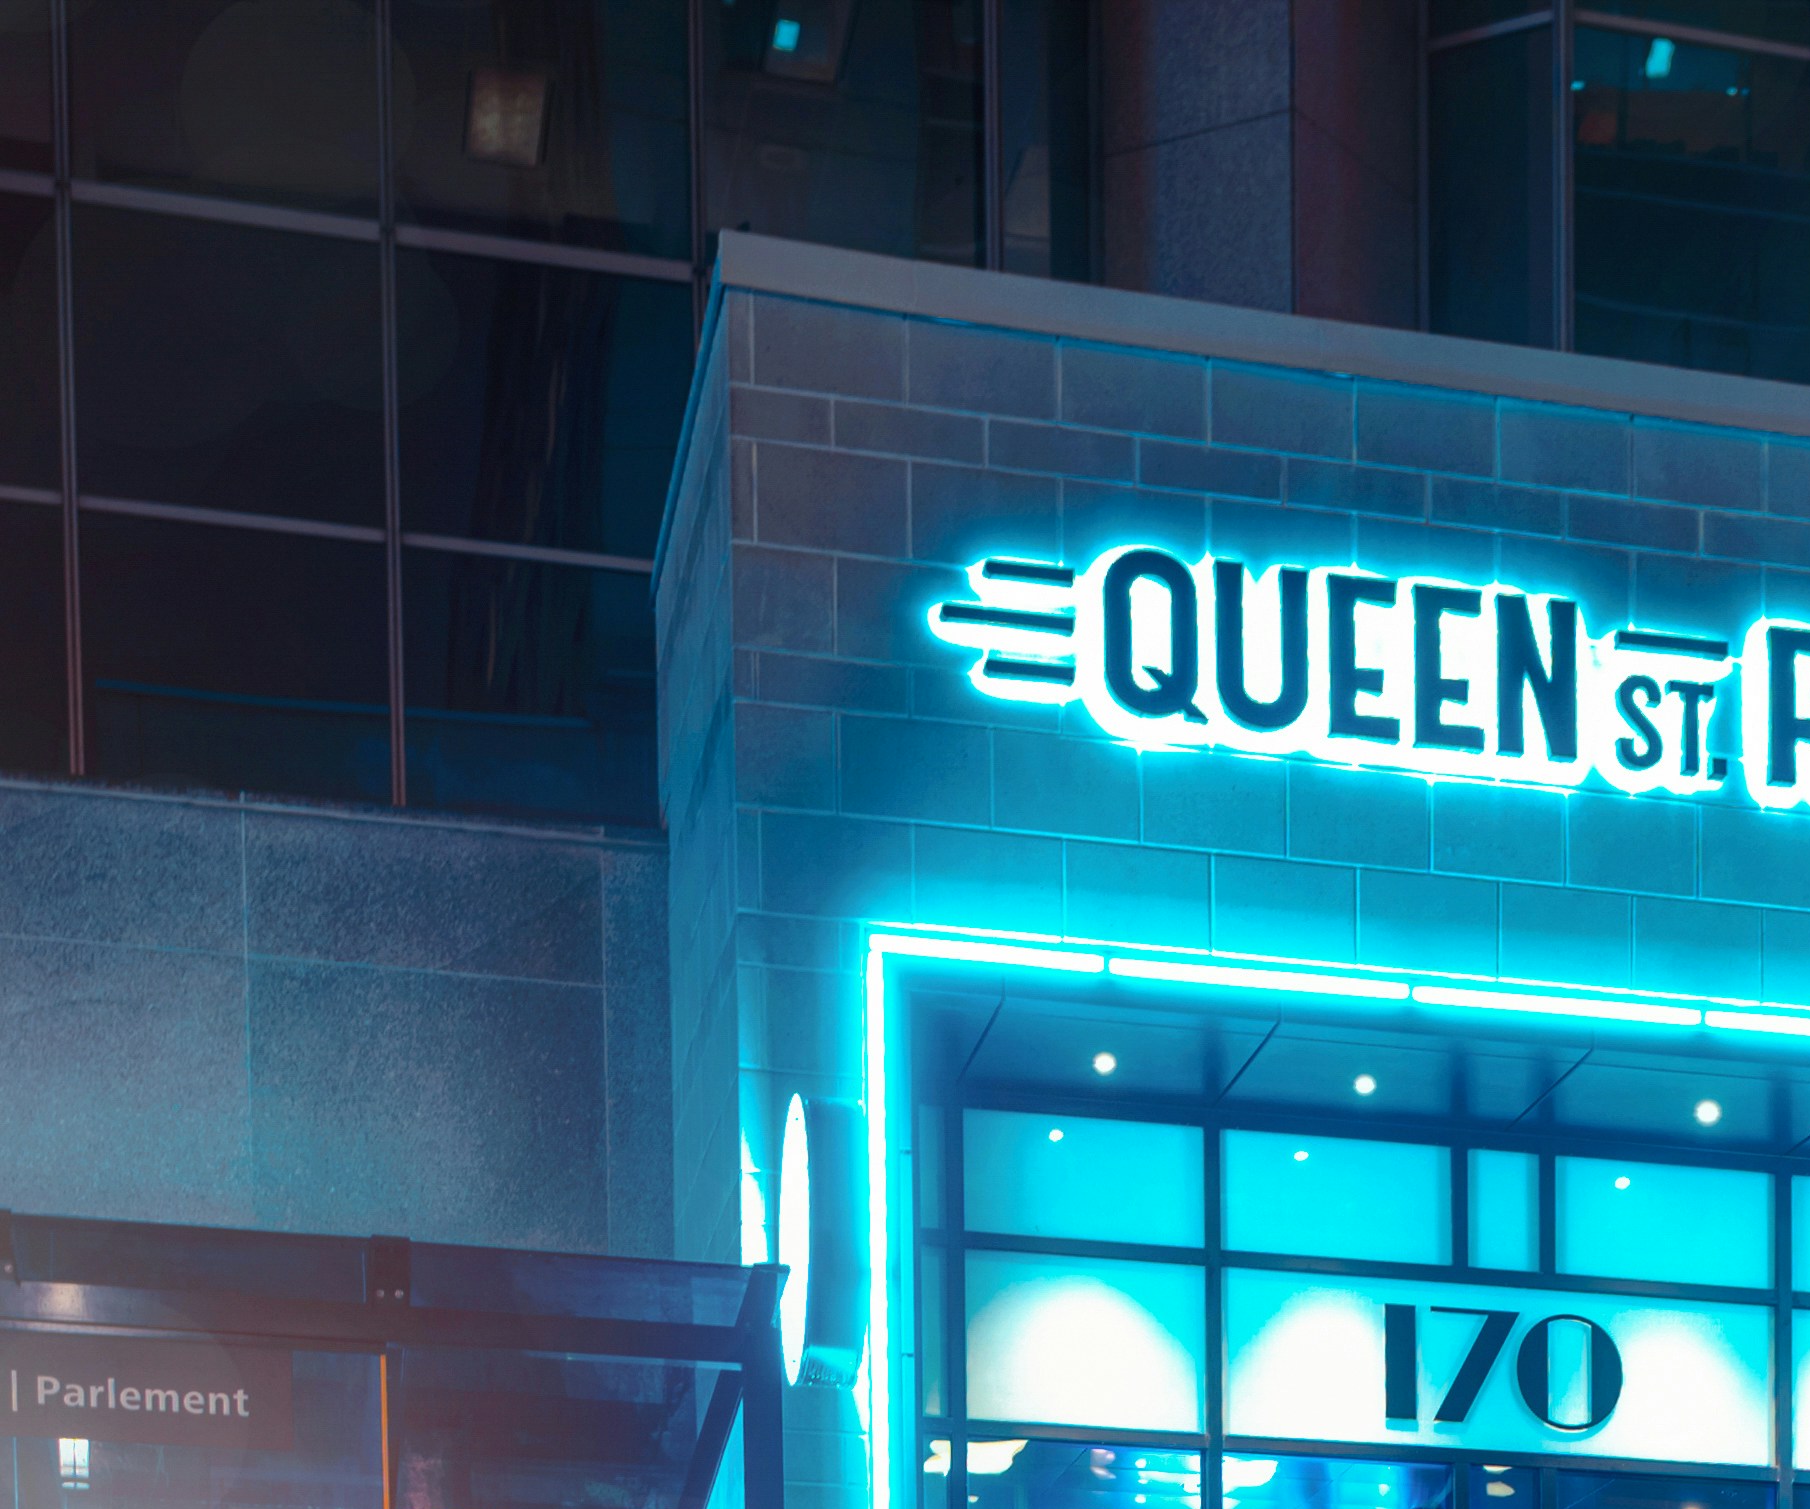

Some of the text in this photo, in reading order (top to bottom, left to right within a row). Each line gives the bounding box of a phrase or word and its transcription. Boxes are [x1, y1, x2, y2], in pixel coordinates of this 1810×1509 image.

[1103, 548, 1579, 761] QUEEN
[37, 1375, 250, 1417] Parlement
[1385, 1303, 1623, 1430] 170
